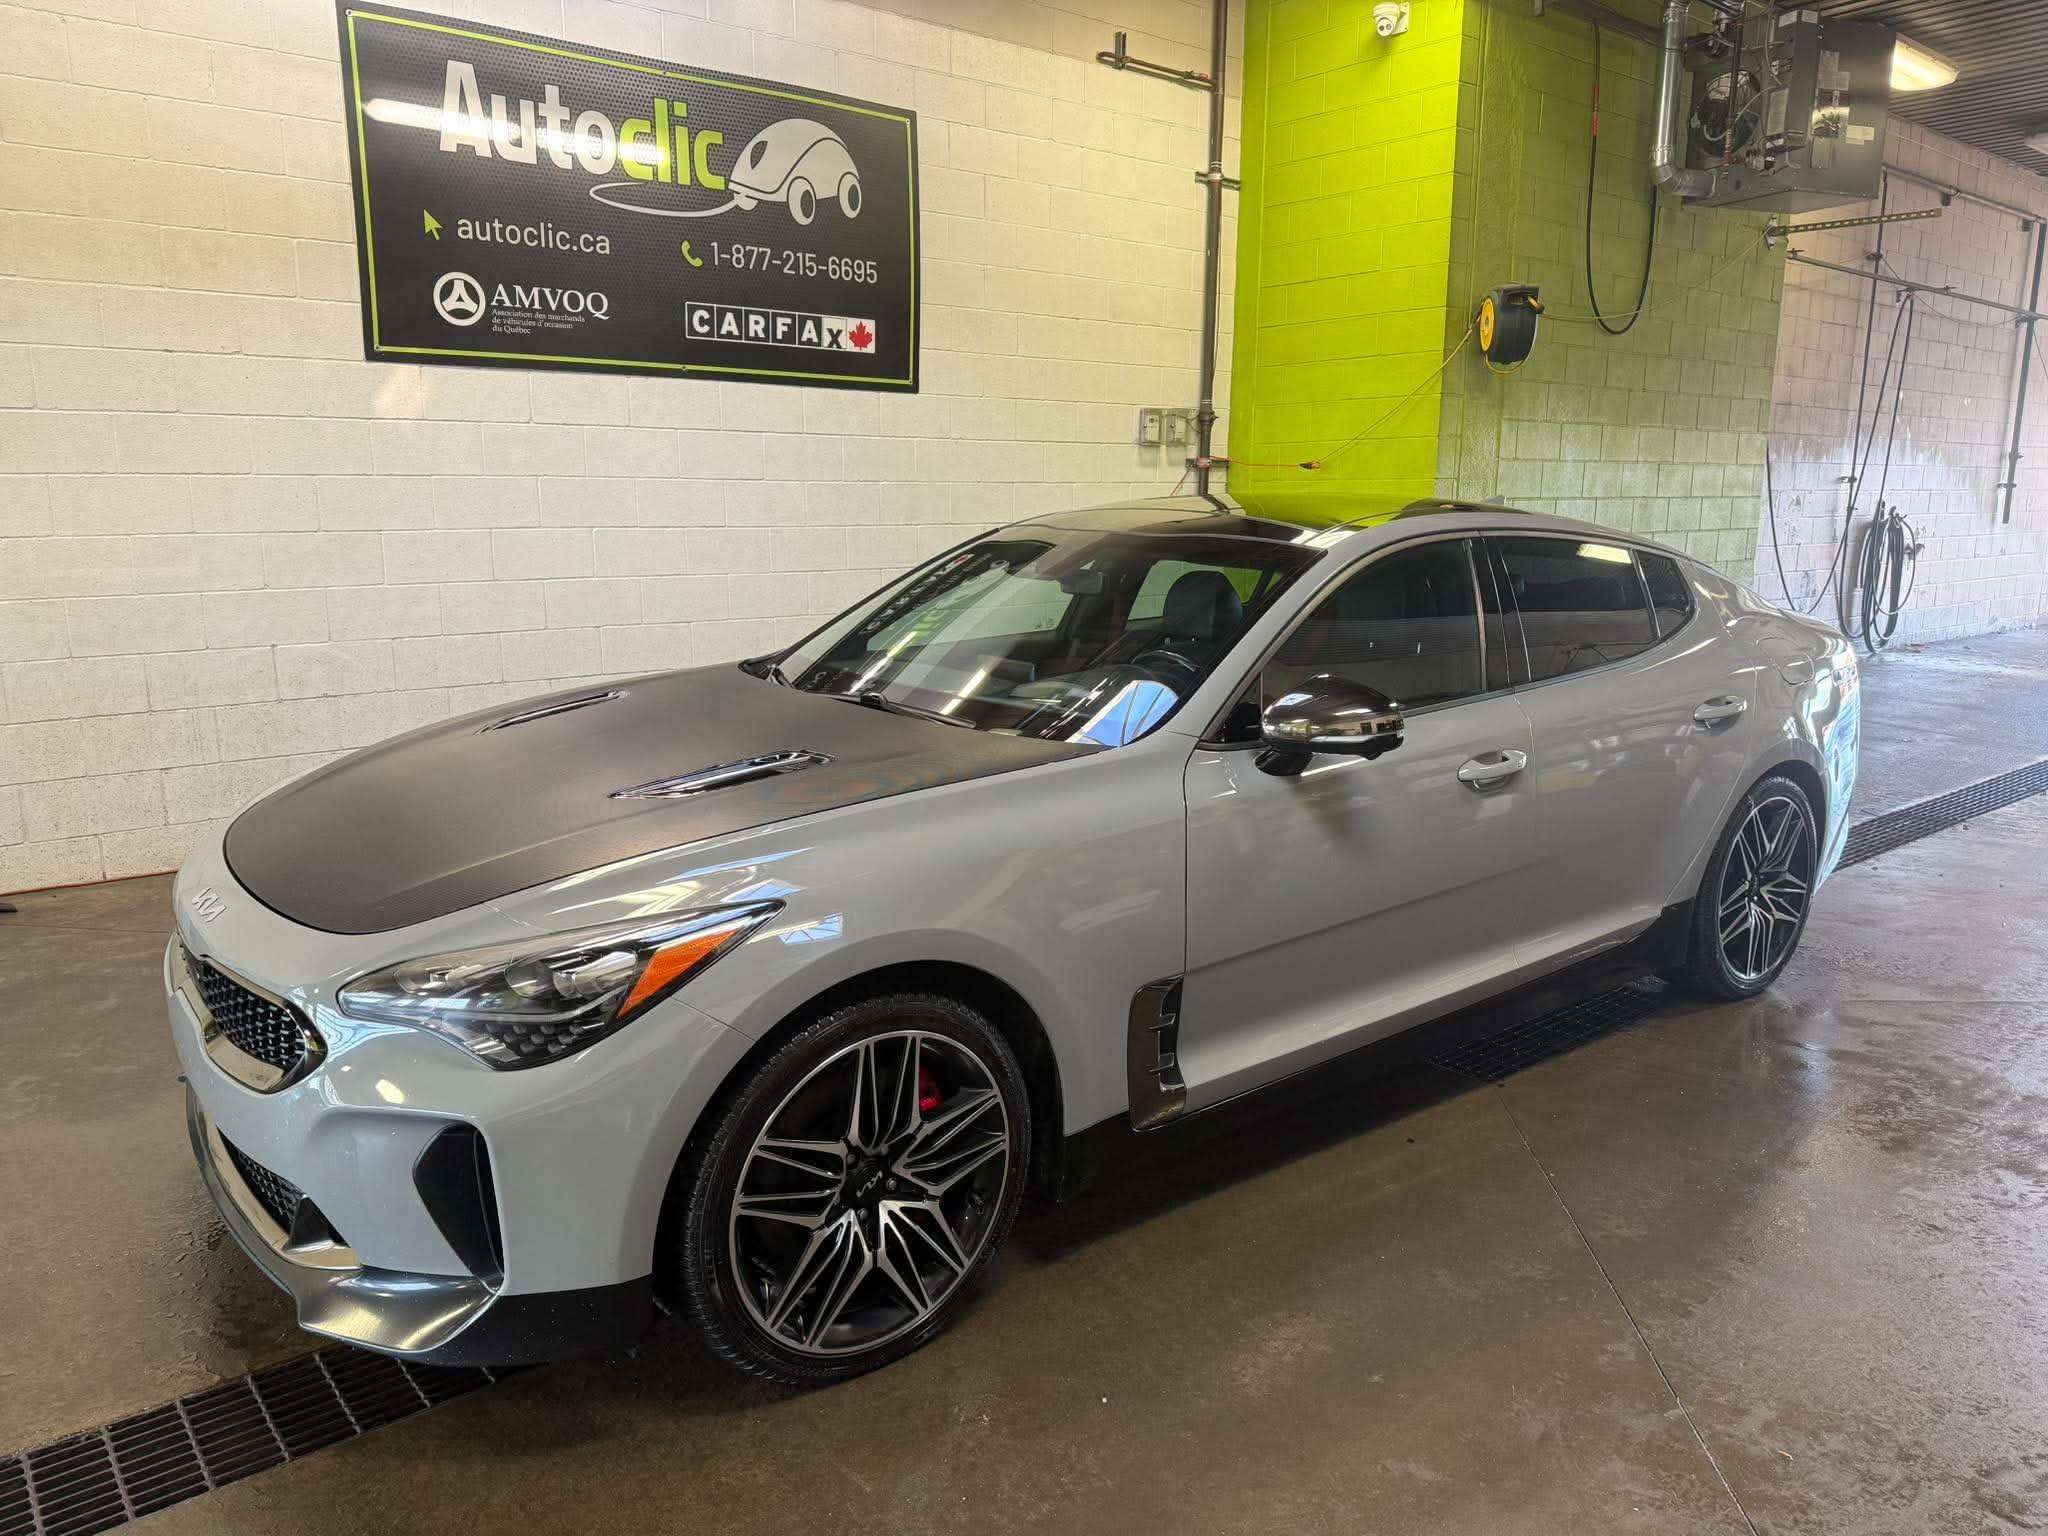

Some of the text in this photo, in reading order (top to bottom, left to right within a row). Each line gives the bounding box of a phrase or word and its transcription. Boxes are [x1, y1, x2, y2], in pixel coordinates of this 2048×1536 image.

[439, 59, 726, 191] Autoclic
[457, 217, 611, 255] autoclic.ca
[710, 241, 878, 284] 1-877-215-6695
[490, 283, 610, 320] AMVOQ
[491, 308, 533, 318] Association
[692, 309, 843, 349] CARFAX
